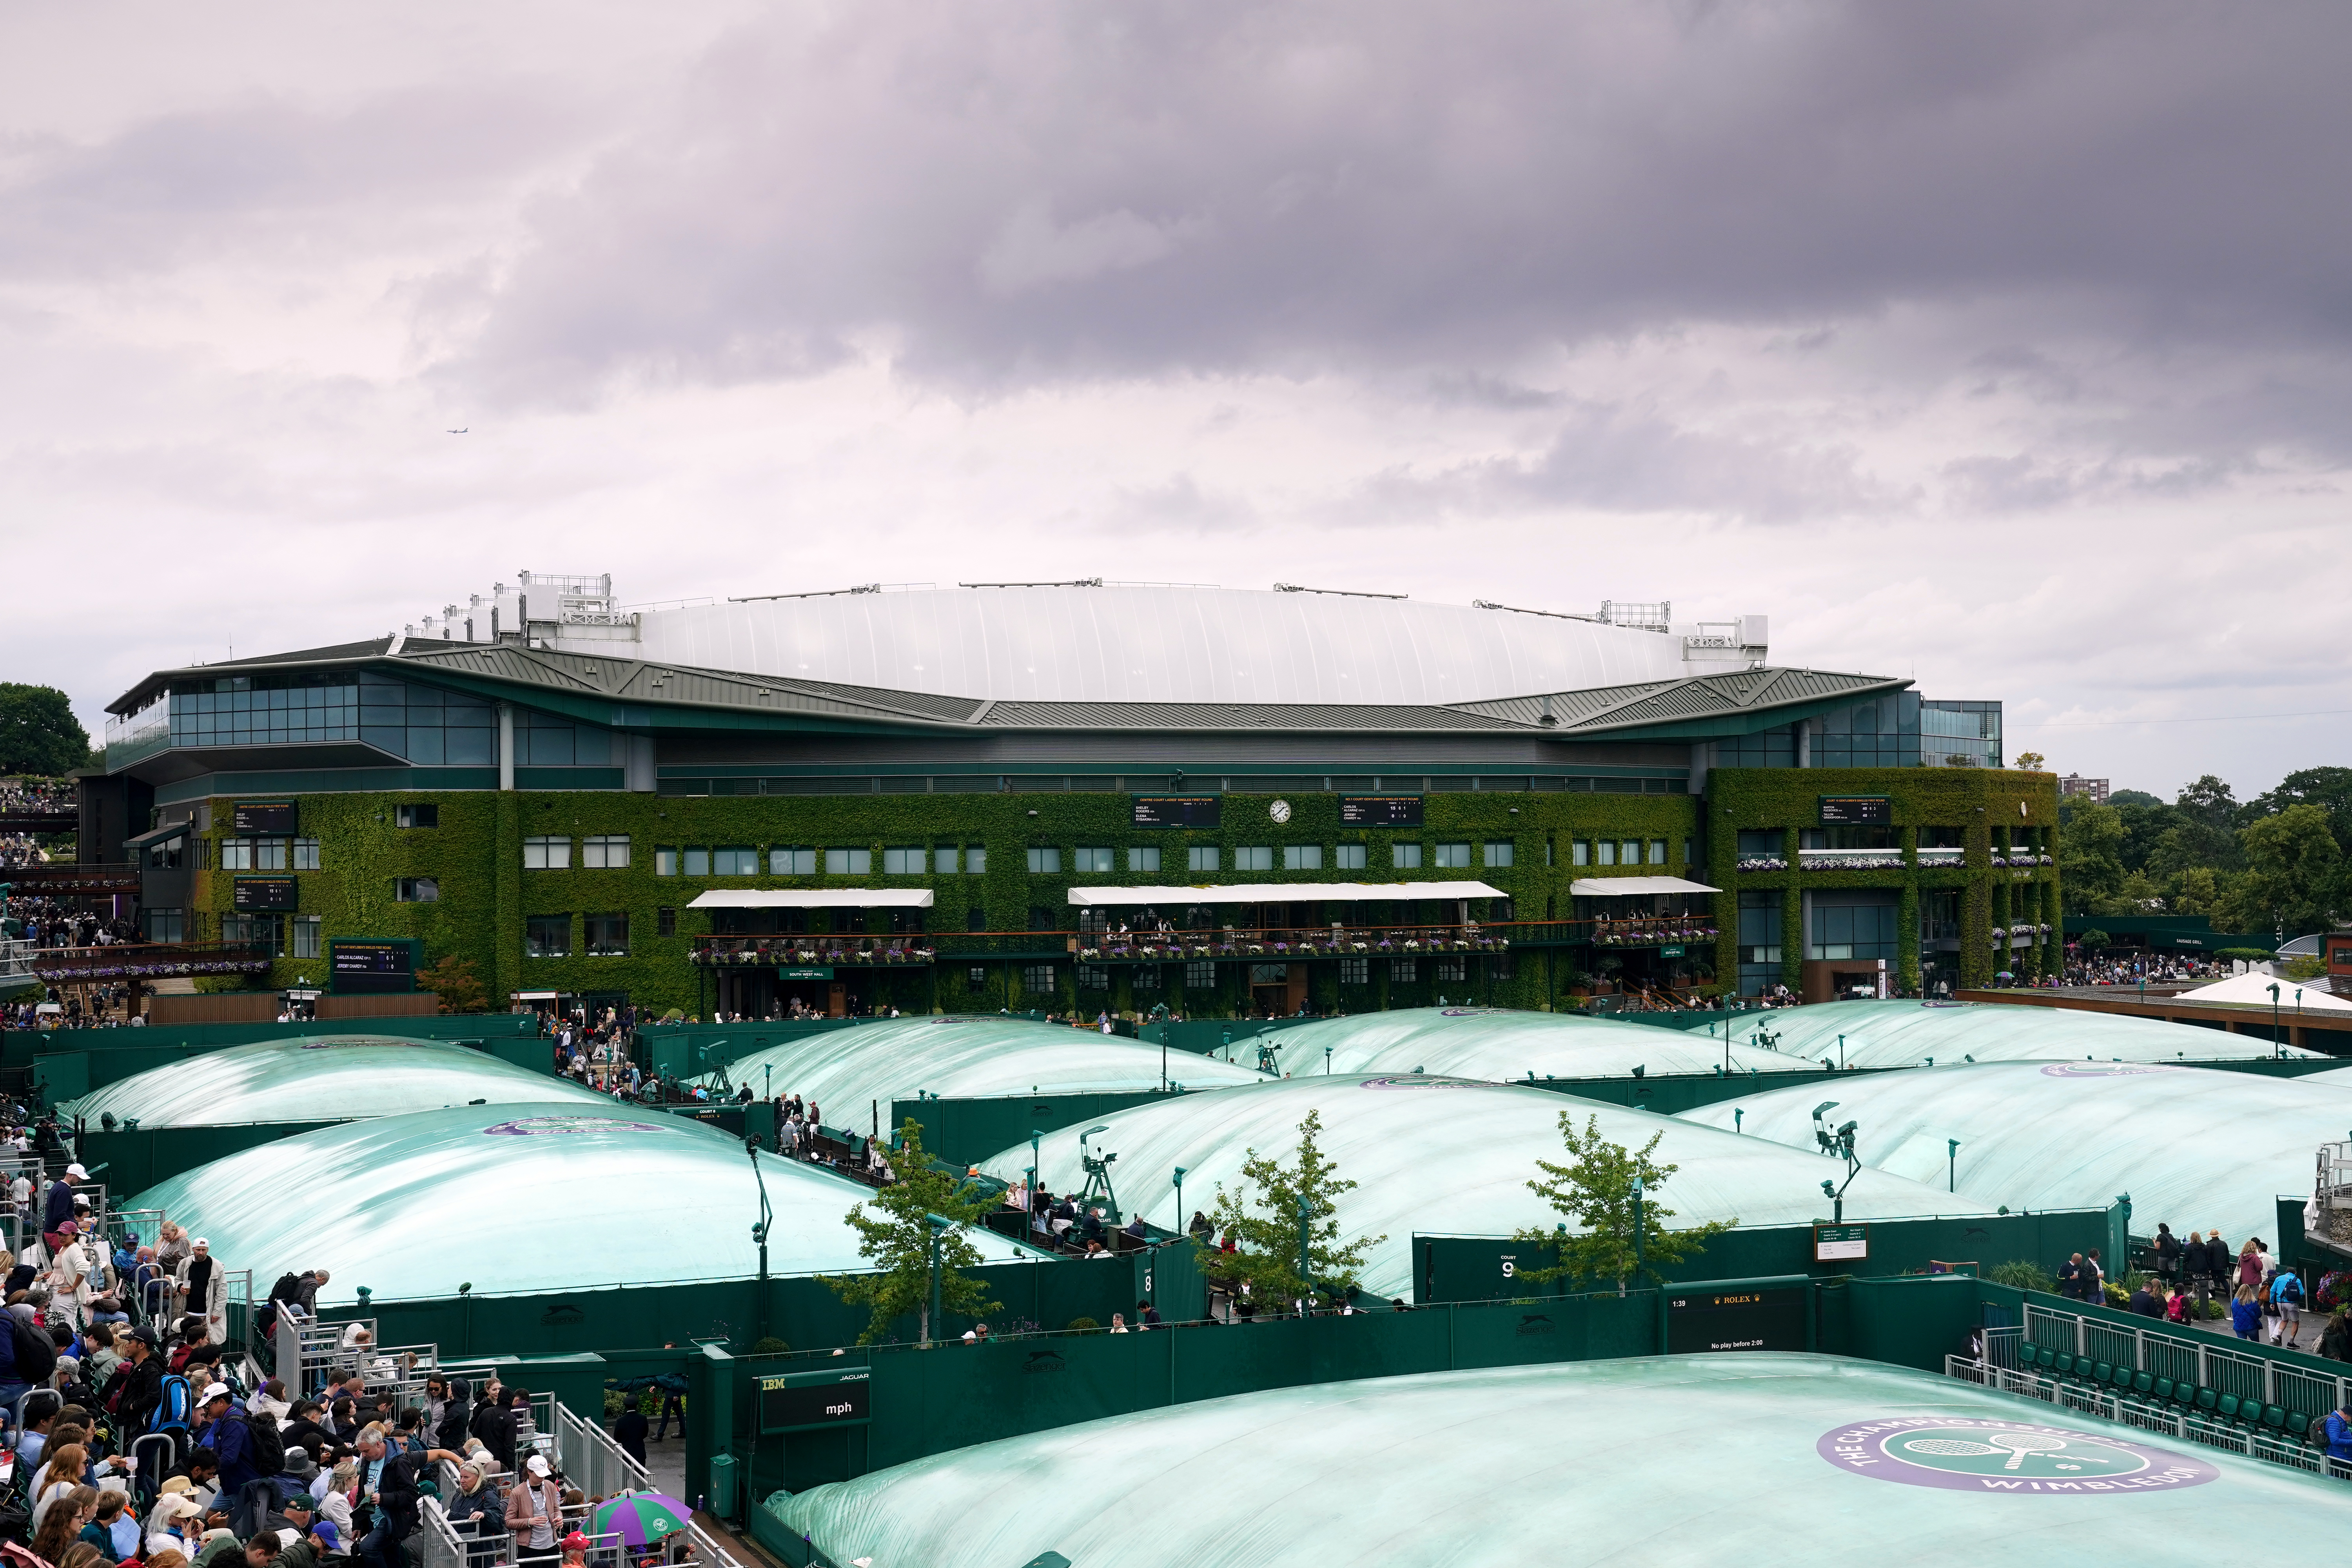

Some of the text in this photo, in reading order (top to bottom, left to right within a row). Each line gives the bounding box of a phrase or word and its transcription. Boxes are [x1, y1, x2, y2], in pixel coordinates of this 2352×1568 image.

[1502, 1262, 1514, 1277] 9
[1145, 1275, 1151, 1292] 8
[1724, 1296, 1750, 1304] ROLEX
[541, 1316, 584, 1325] Slazenger
[1516, 1326, 1556, 1334] Slazenger
[1022, 1363, 1066, 1373] Slazenger
[762, 1378, 785, 1391] IBM
[826, 1402, 852, 1415] mph
[1834, 1419, 2138, 1467] THE CHAMPIONSHIPS
[1981, 1465, 2200, 1490] WIMBLEDON
